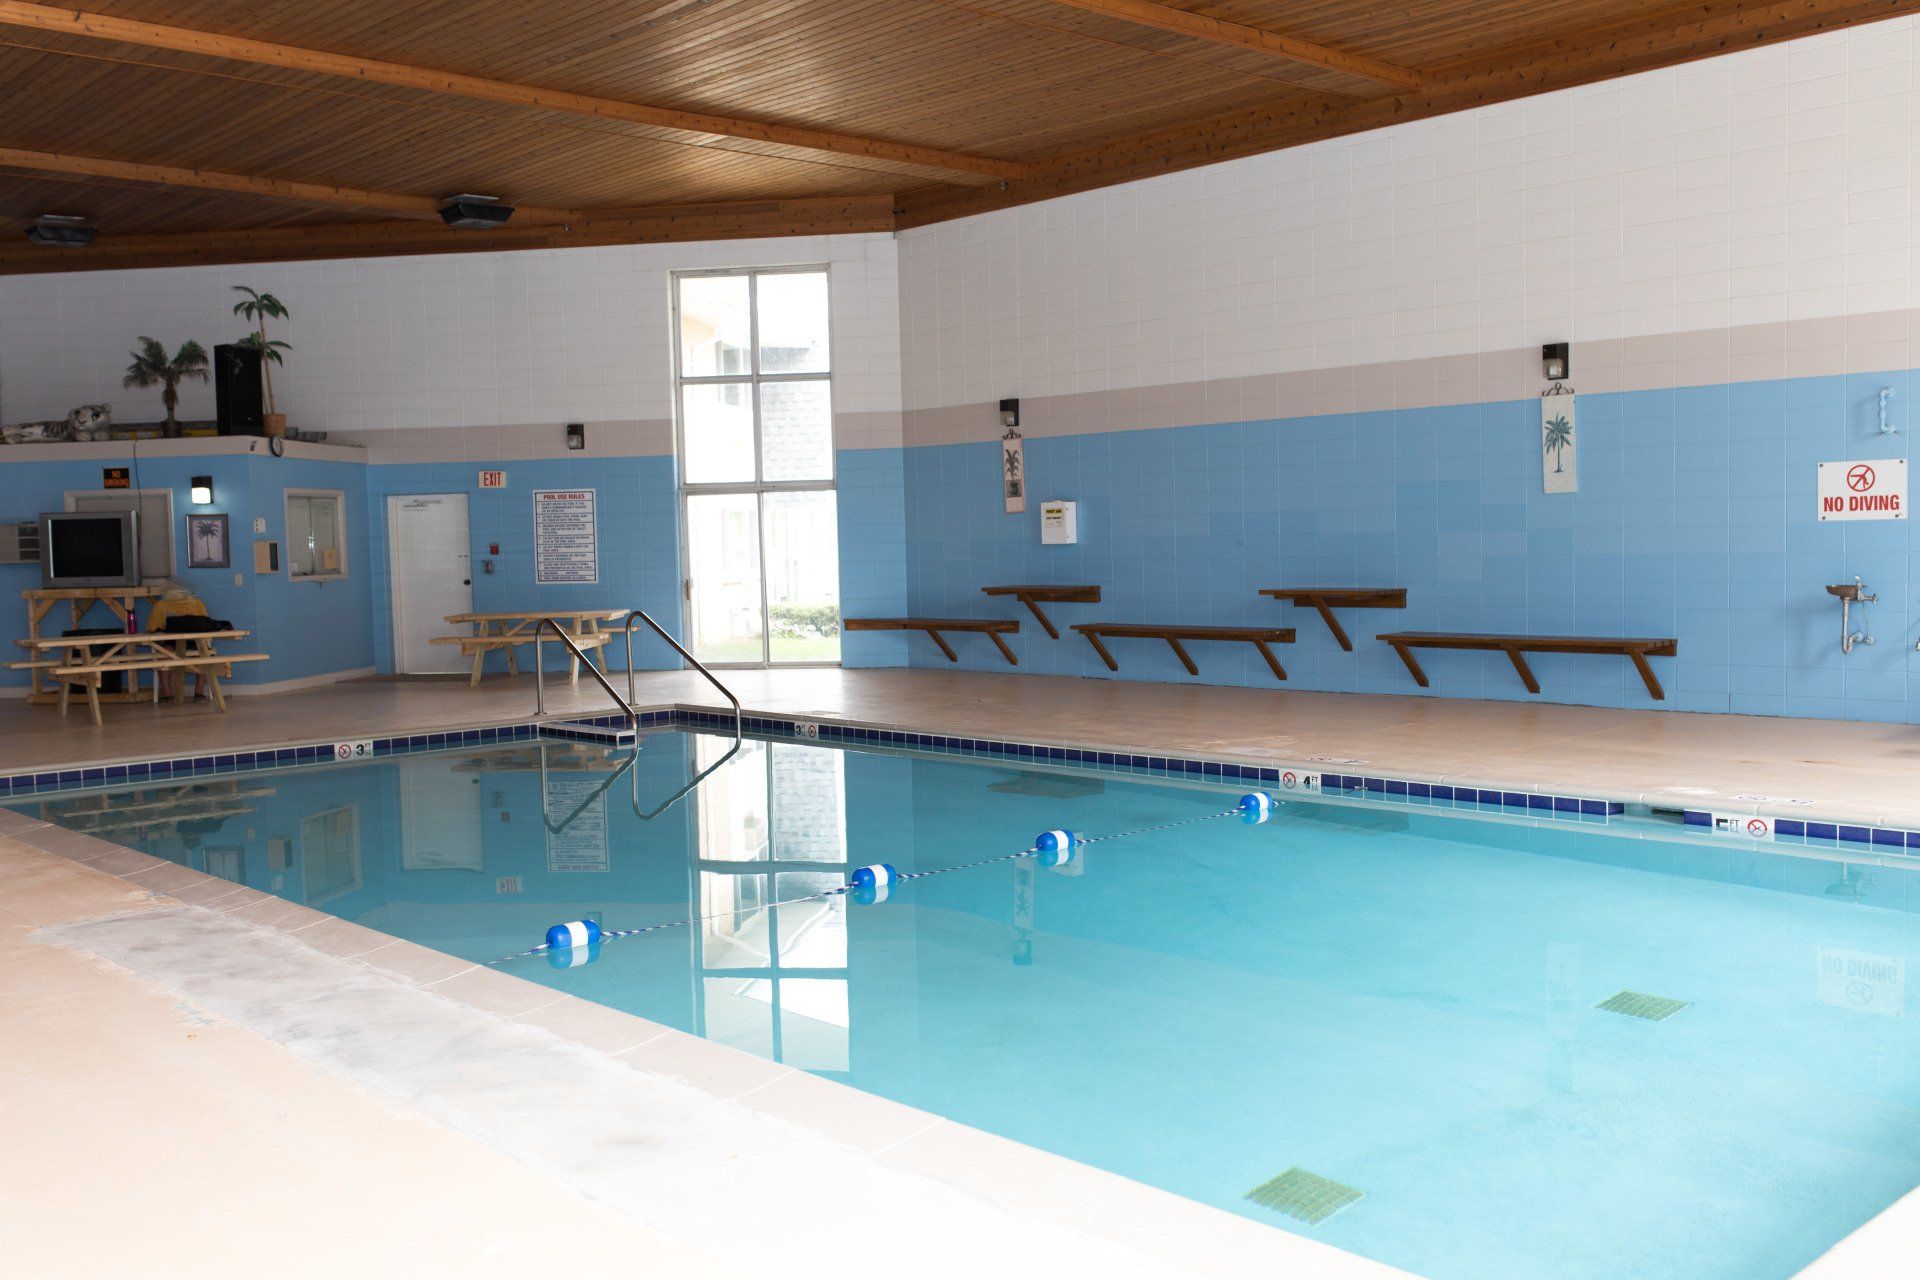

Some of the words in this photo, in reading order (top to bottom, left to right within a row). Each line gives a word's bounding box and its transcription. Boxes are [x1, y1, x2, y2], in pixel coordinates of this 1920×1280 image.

[112, 470, 120, 478] NO
[483, 472, 501, 486] EXIT
[1823, 496, 1844, 512] NO
[1849, 494, 1900, 512] DIVING
